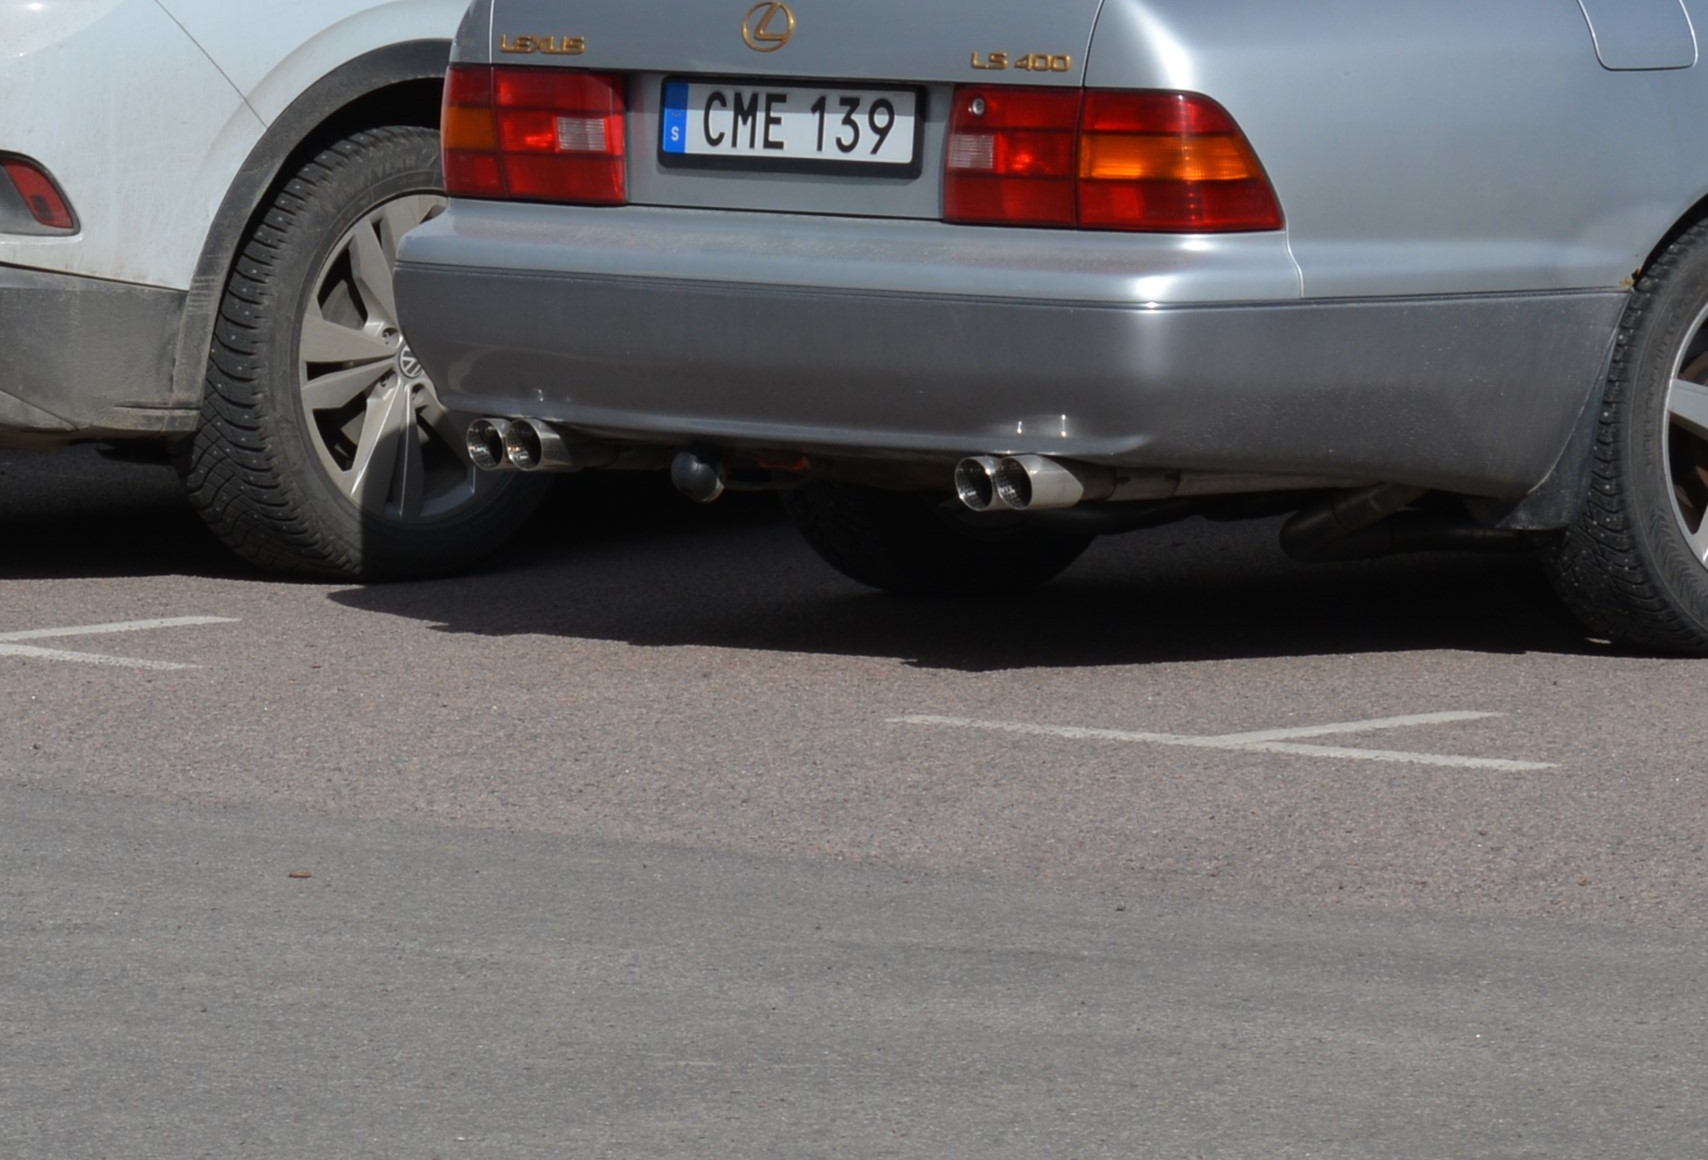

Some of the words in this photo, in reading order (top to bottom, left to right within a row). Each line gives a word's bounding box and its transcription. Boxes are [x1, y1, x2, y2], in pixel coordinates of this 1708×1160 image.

[499, 34, 586, 55] LEXUS
[970, 51, 1009, 70] LS
[1014, 53, 1072, 72] 400
[670, 126, 680, 142] S
[703, 91, 788, 151] CME
[810, 95, 896, 156] 139
